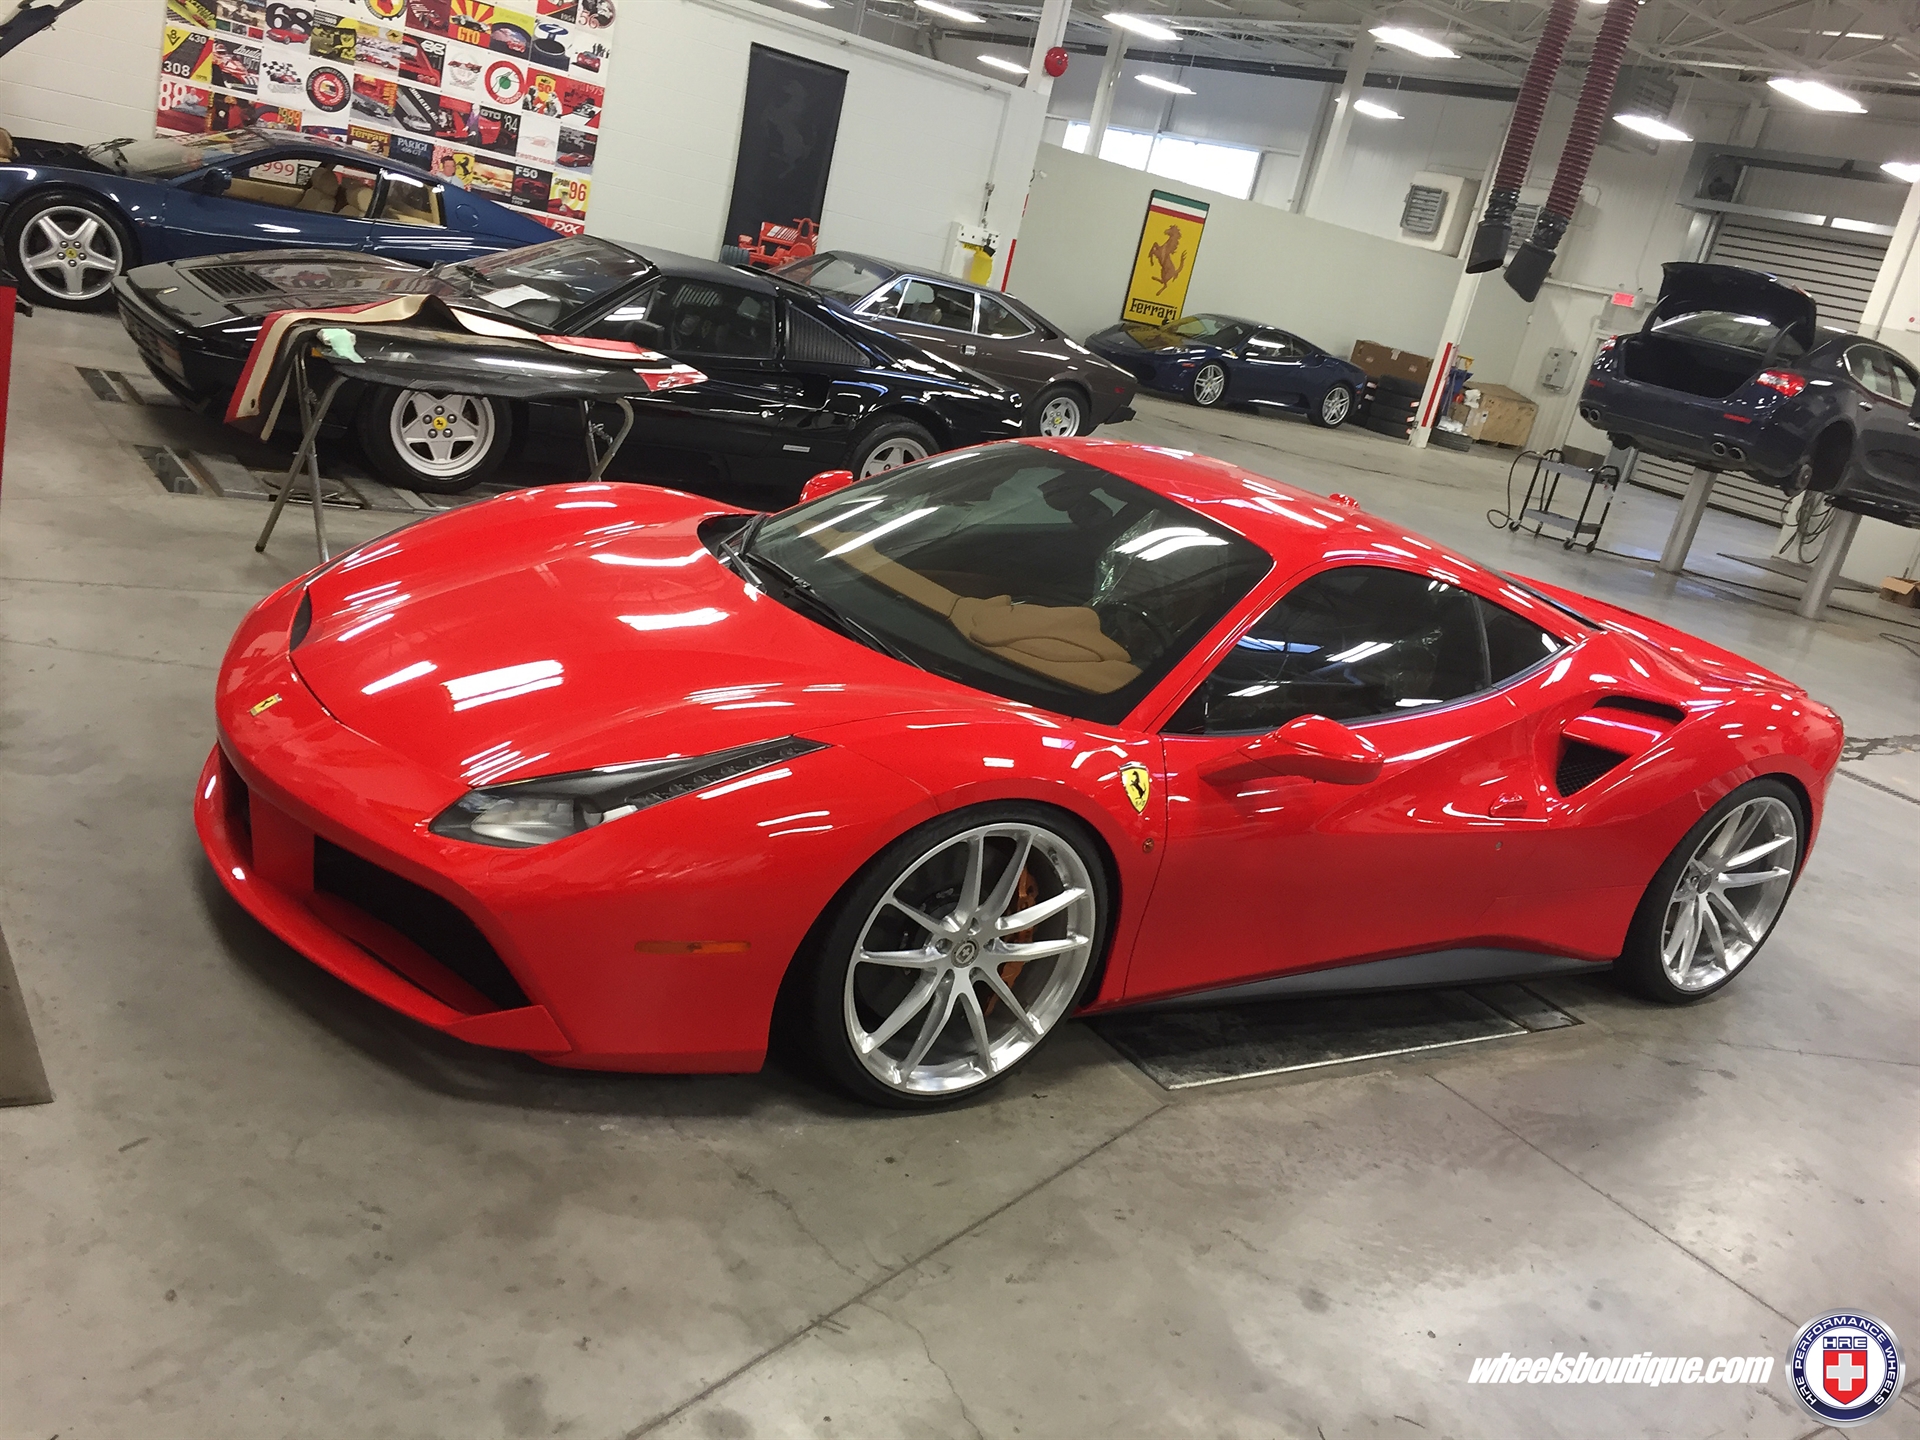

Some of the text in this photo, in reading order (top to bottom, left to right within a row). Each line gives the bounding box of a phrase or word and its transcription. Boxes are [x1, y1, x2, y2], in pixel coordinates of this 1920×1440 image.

[266, 3, 314, 36] 68
[579, 10, 599, 29] 56
[188, 33, 207, 45] 430
[457, 26, 480, 44] GTO
[163, 60, 191, 77] 308
[158, 81, 187, 111] 88
[537, 82, 552, 94] 50
[585, 84, 604, 96] 1975
[480, 108, 501, 120] GTO
[350, 127, 389, 144] Ferrari
[397, 138, 428, 151] PARIGI
[515, 166, 538, 179] F50
[569, 181, 587, 202] 96
[552, 221, 580, 235] FXX
[1129, 298, 1178, 321] Ferrari
